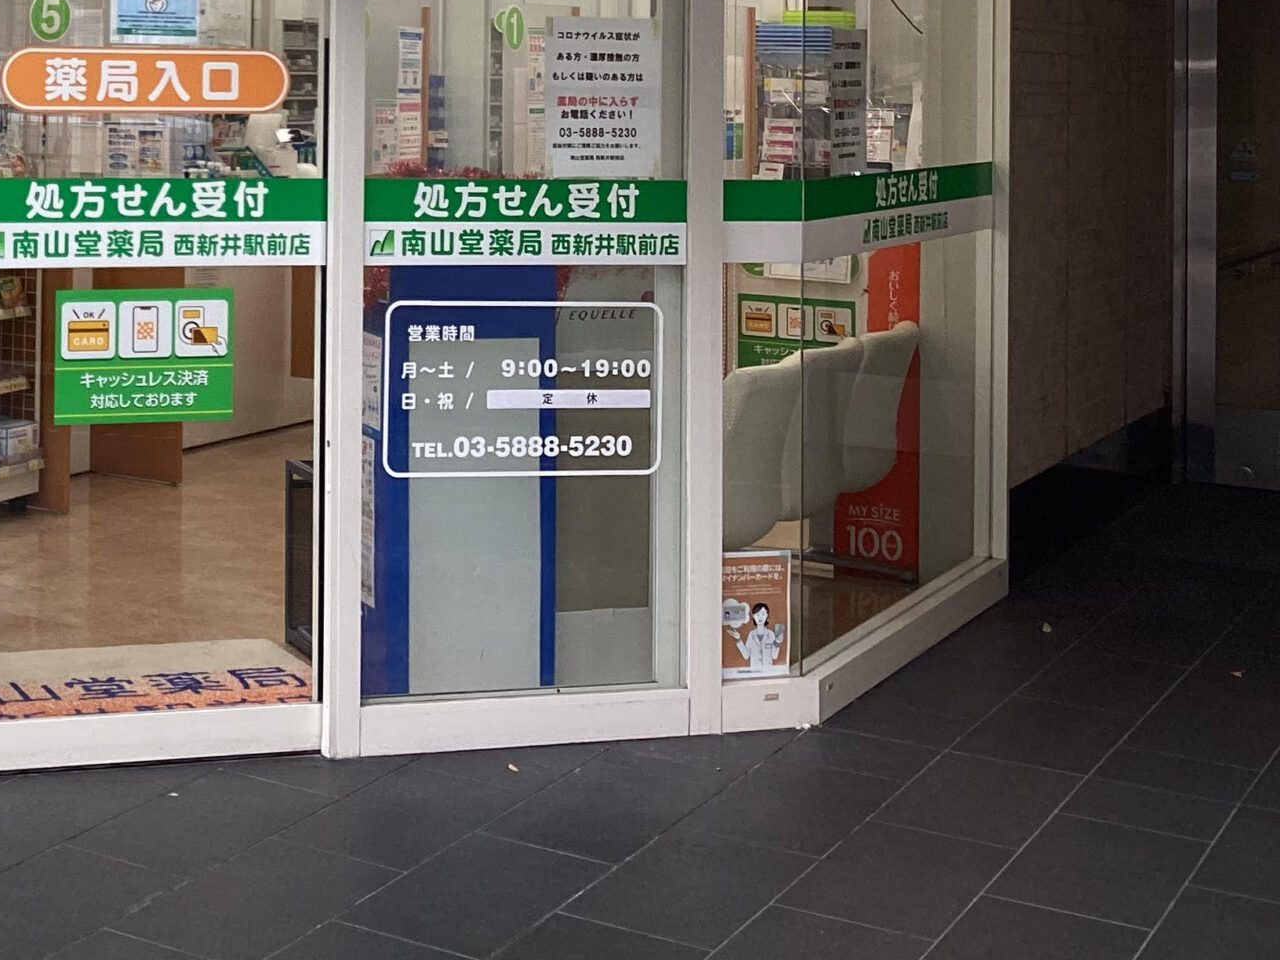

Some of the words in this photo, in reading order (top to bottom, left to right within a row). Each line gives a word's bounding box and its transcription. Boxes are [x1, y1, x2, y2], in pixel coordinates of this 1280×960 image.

[557, 31, 641, 41] コロナウイルス症状が
[45, 57, 240, 102] 薬局入口
[559, 127, 637, 138] 03-5888-5230
[875, 170, 938, 208] 処方せん受付
[25, 181, 269, 219] 処方せん受付
[413, 182, 640, 219] 処方せん受付
[872, 213, 912, 242] 南山堂薬局
[12, 229, 164, 258] 南山堂薬局
[173, 232, 311, 257] 西新井駅前店
[401, 229, 543, 257] 南山堂薬局
[551, 232, 680, 257] 西新井駅前店
[83, 310, 95, 319] OK
[568, 308, 639, 321] EQUELLE
[73, 336, 105, 346] CARD
[407, 324, 476, 342] 営業時間
[80, 369, 209, 388] キャッシュレス決済
[90, 392, 198, 409] 対応しております
[401, 392, 455, 410] 日・祝
[846, 525, 903, 560] 100
